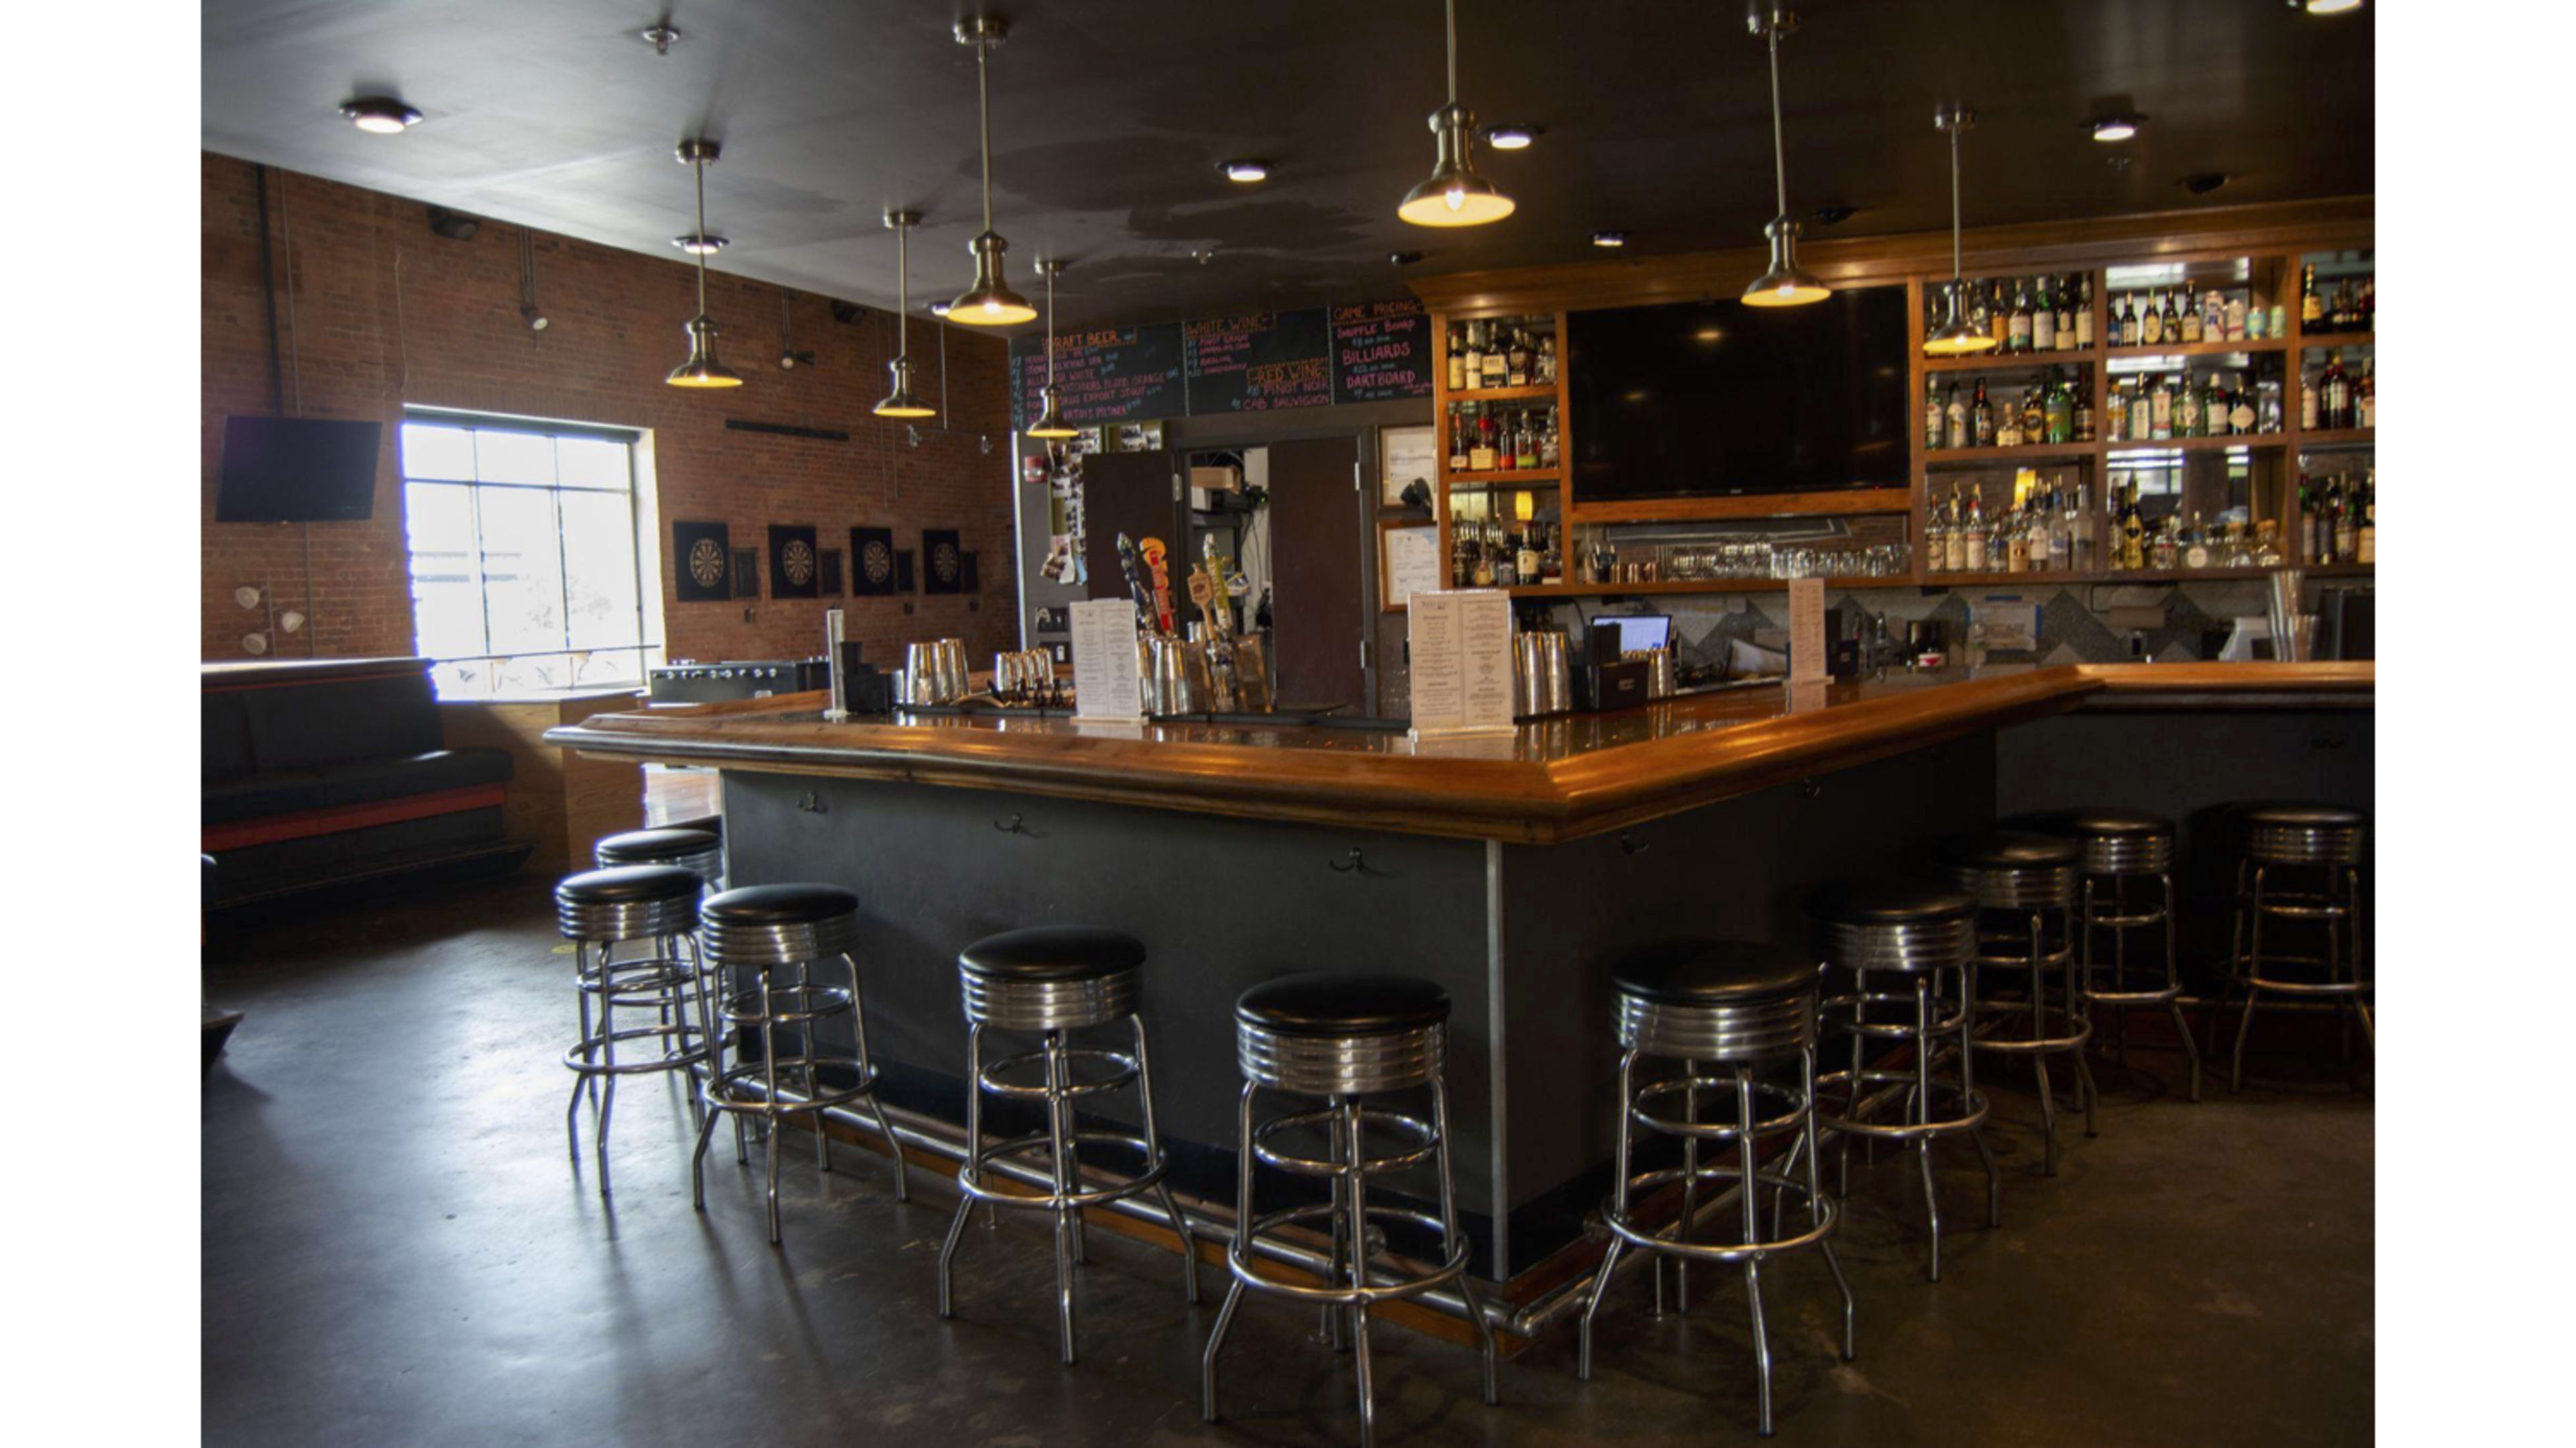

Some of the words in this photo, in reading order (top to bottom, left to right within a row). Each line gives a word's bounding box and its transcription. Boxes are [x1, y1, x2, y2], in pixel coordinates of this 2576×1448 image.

[1334, 305, 1365, 321] GAME
[1187, 319, 1223, 336] WHITE
[1228, 313, 1262, 331] WINE
[1087, 329, 1121, 346] BEER
[1342, 342, 1411, 366] BILLIARDS
[1258, 366, 1284, 383] RED
[1288, 362, 1322, 380] WINE
[1264, 380, 1296, 396] PINOT
[1303, 376, 1328, 391] NOIR
[1242, 397, 1267, 410] CAB
